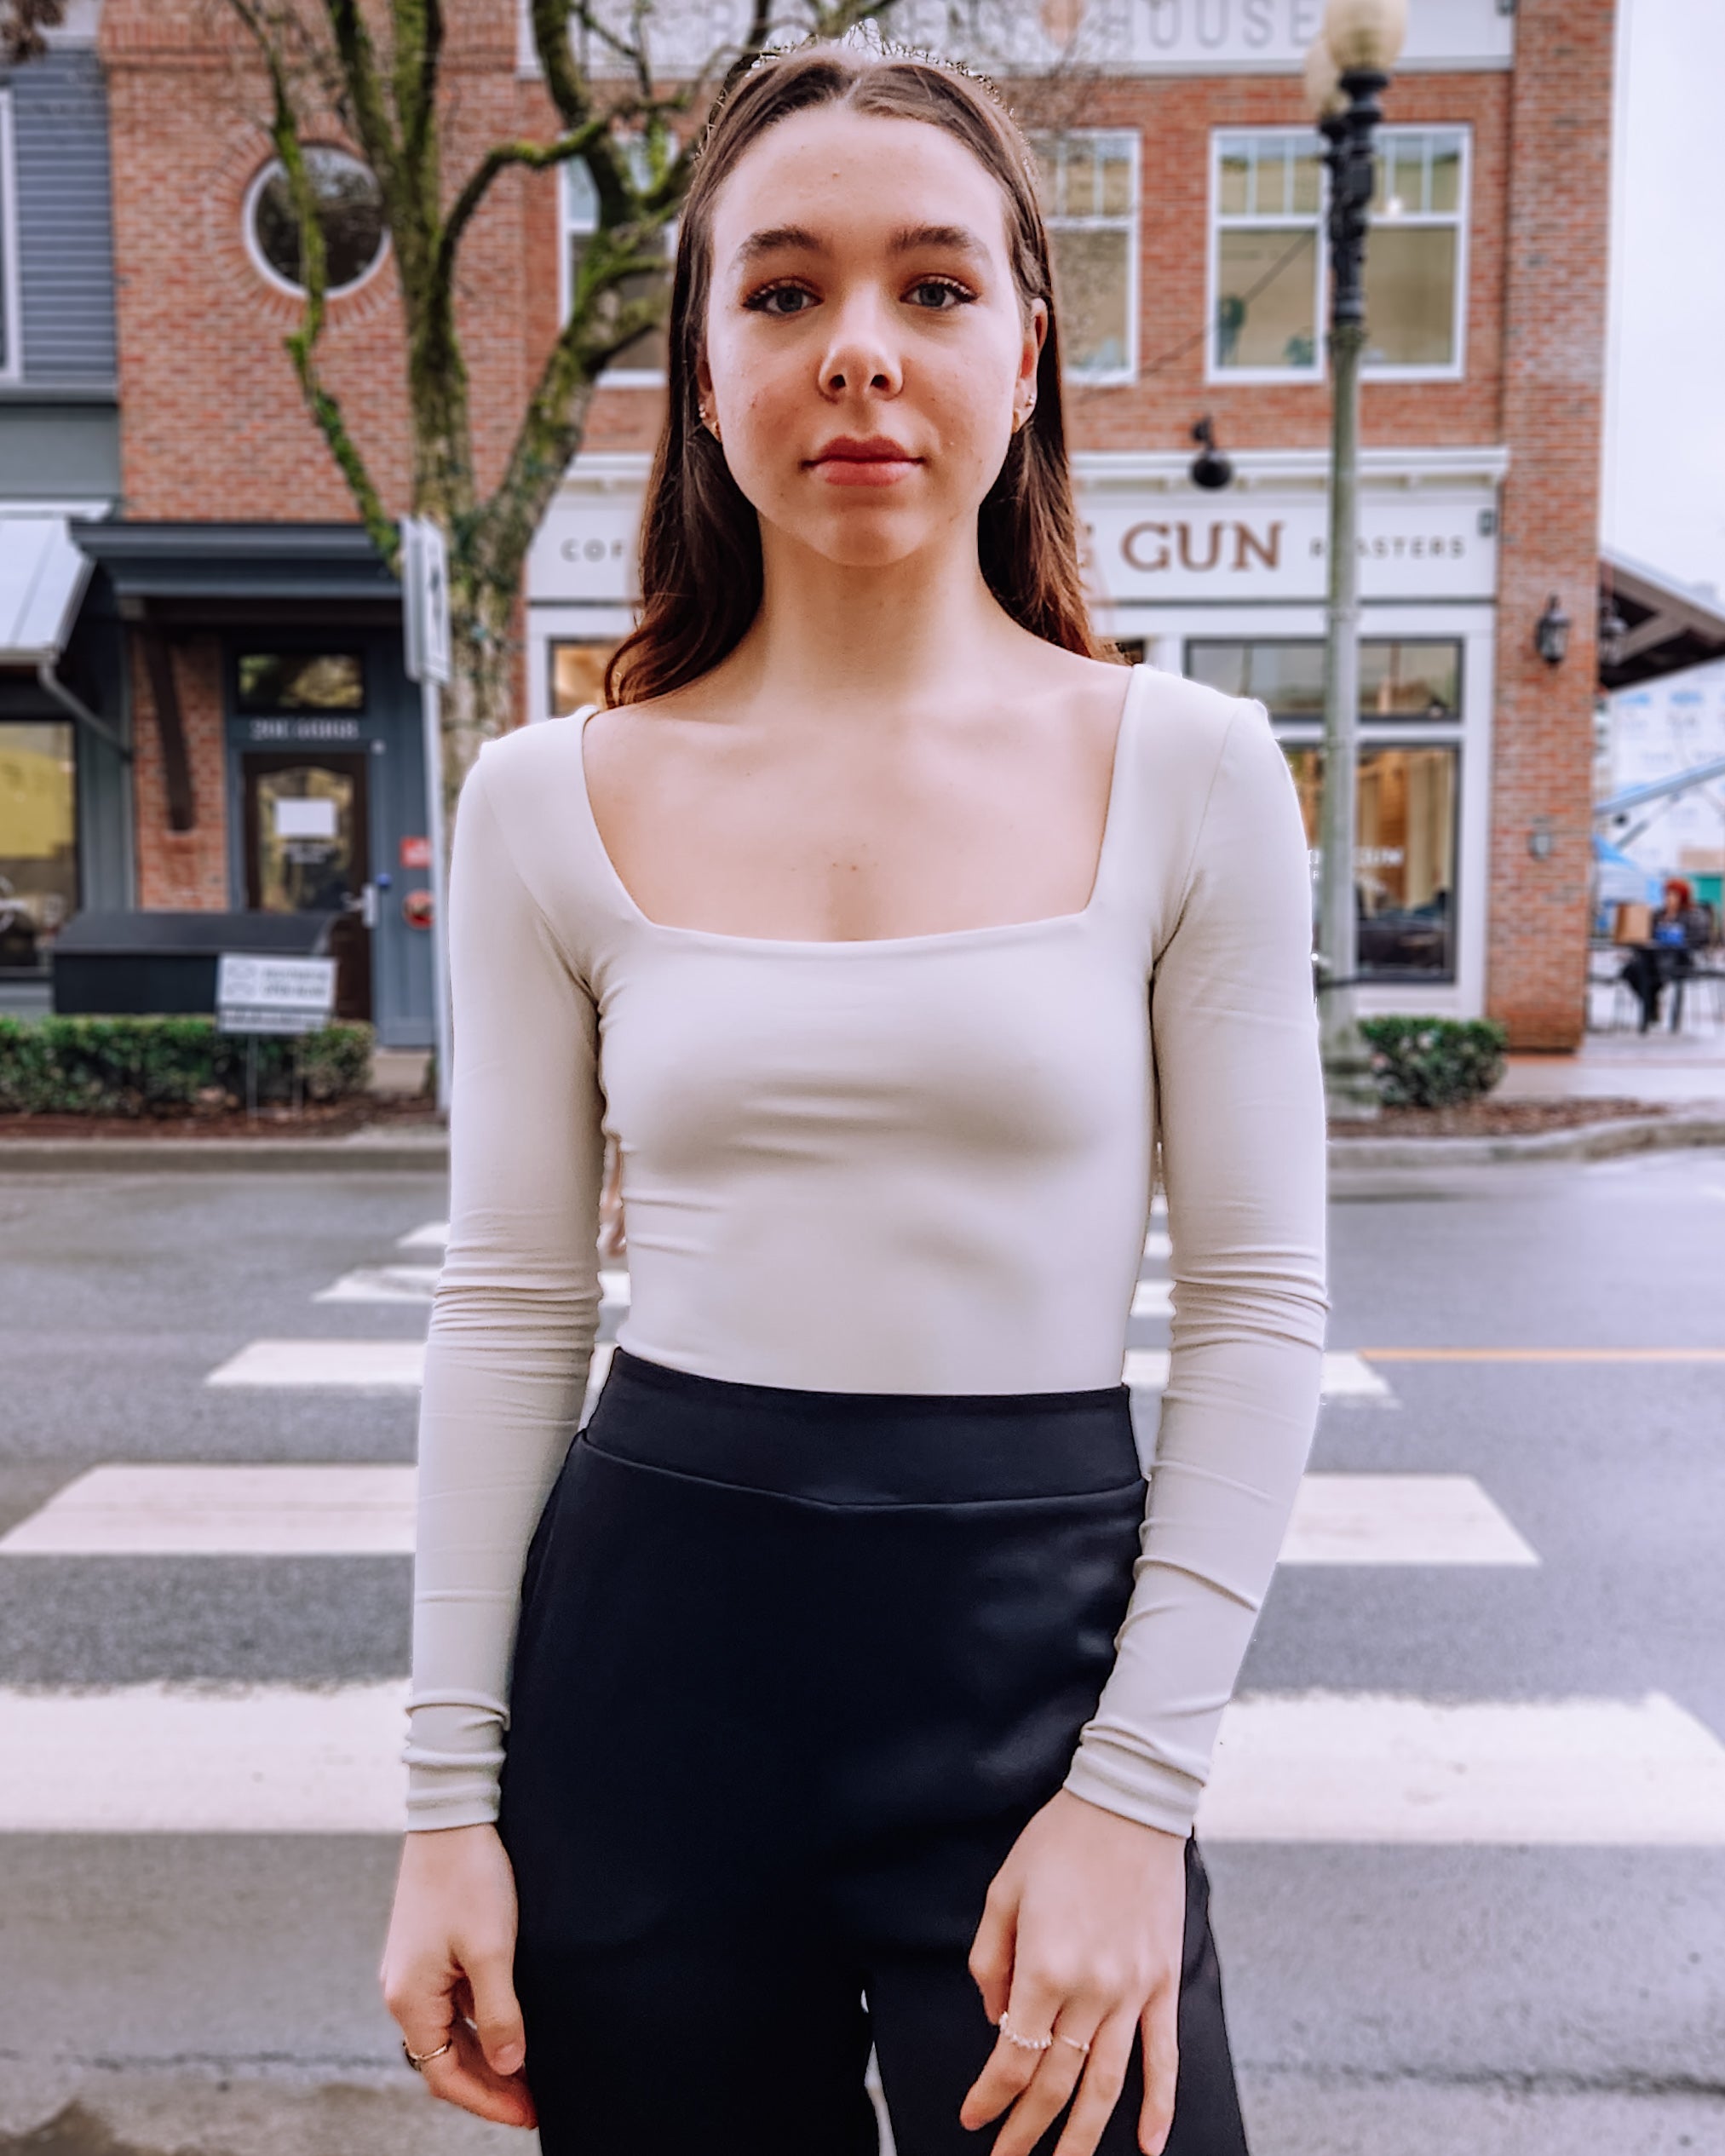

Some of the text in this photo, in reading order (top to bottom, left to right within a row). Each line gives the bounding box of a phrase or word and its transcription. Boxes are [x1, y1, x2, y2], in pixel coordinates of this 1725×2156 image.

[560, 538, 625, 563] COF
[1119, 520, 1285, 572] GUN
[1308, 535, 1467, 560] RASTERS
